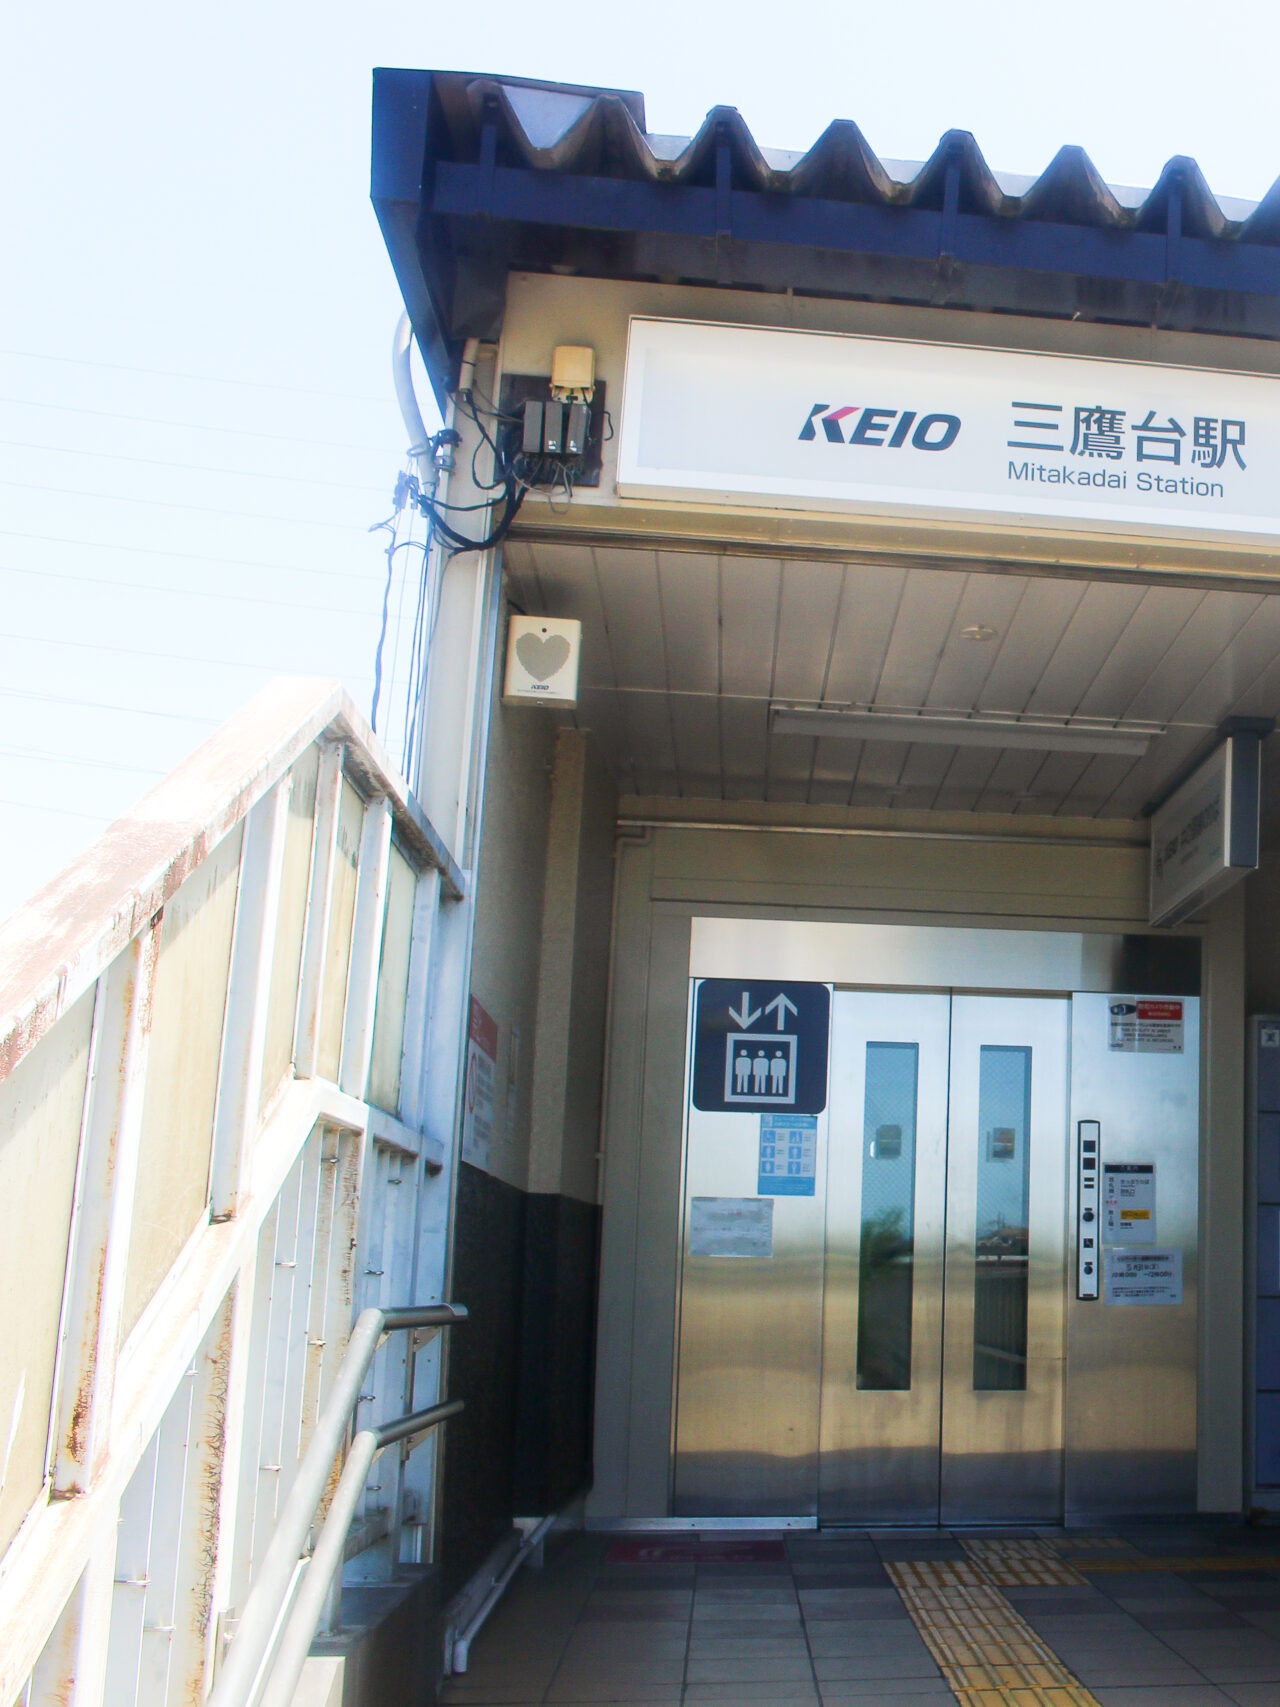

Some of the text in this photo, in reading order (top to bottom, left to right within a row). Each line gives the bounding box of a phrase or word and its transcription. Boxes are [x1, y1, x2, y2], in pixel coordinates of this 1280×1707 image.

[797, 403, 962, 451] KEIO
[1007, 401, 1247, 471] 三鷹台駅
[1007, 460, 1224, 498] Mitakadai Station
